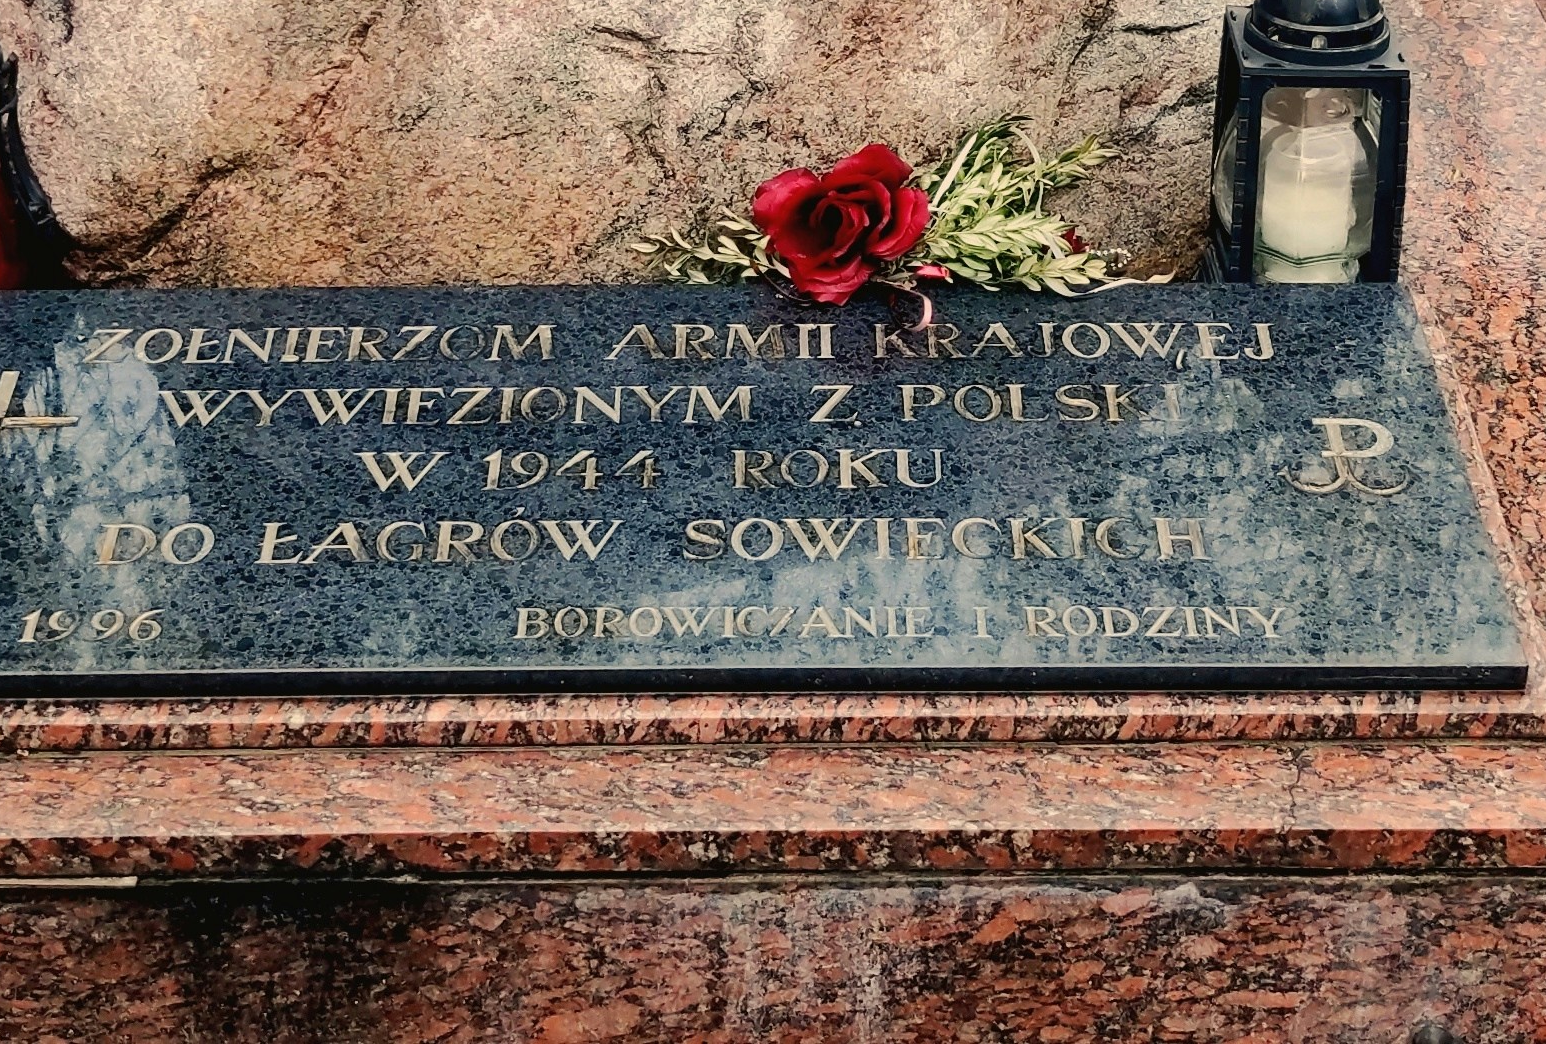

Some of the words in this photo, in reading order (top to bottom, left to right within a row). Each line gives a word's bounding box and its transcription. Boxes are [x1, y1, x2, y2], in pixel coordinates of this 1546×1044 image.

[605, 323, 834, 360] ARMII
[873, 322, 1277, 360] KRAJOWEJ
[158, 385, 754, 427] WYWIEZIONYM
[809, 384, 857, 424] Z
[898, 383, 1187, 423] POLSKI
[355, 452, 448, 492] W
[483, 448, 662, 491] 1944
[733, 449, 944, 489] ROKU
[94, 523, 216, 566] DO
[254, 507, 623, 565] ŁAGRÓW
[684, 517, 1211, 561] SOWIECKICH
[18, 609, 164, 643] 1996
[514, 606, 936, 640] BOROWICZANIE
[971, 606, 992, 639] I
[1026, 606, 1285, 640] RODZINY
